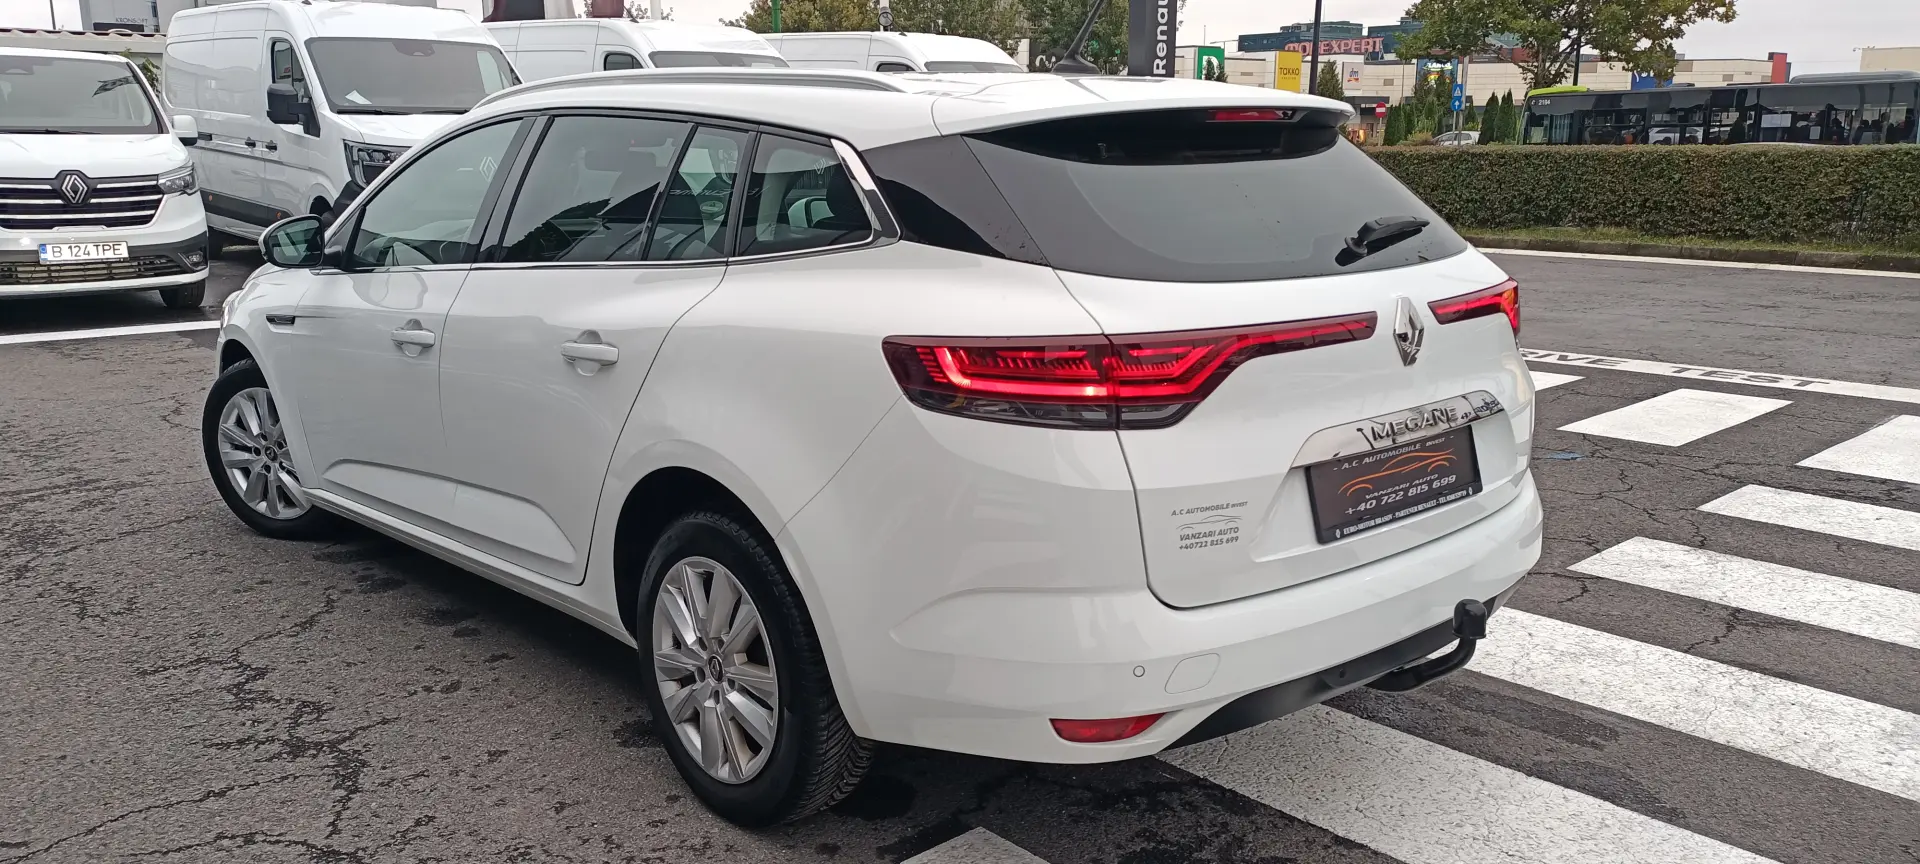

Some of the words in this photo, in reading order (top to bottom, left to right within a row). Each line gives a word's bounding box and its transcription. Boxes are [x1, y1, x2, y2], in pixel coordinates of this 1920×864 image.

[1285, 37, 1384, 56] MOEXPERT
[52, 246, 62, 258] B
[68, 245, 90, 257] 124
[93, 243, 123, 256] TPE
[1670, 365, 1830, 387] TEST
[1373, 406, 1457, 439] MEGANE
[1341, 460, 1359, 470] A.C
[1362, 443, 1422, 465] AUTOMOBILE
[1425, 437, 1446, 447] INVEST
[1345, 500, 1376, 515] +40
[1381, 491, 1404, 505] 722
[1408, 485, 1429, 497] 815
[1432, 475, 1457, 489] 699
[1365, 483, 1410, 499] VANZARI
[1412, 473, 1439, 485] AUTO
[1171, 508, 1184, 516] A.C
[1185, 503, 1230, 515] AUTOMOBILE
[1231, 501, 1248, 509] INVEST
[1179, 530, 1215, 541] VANZARI
[1217, 527, 1239, 537] AUTO
[1179, 541, 1208, 550] +40722
[1210, 538, 1224, 547] 815
[1225, 536, 1239, 545] 699
